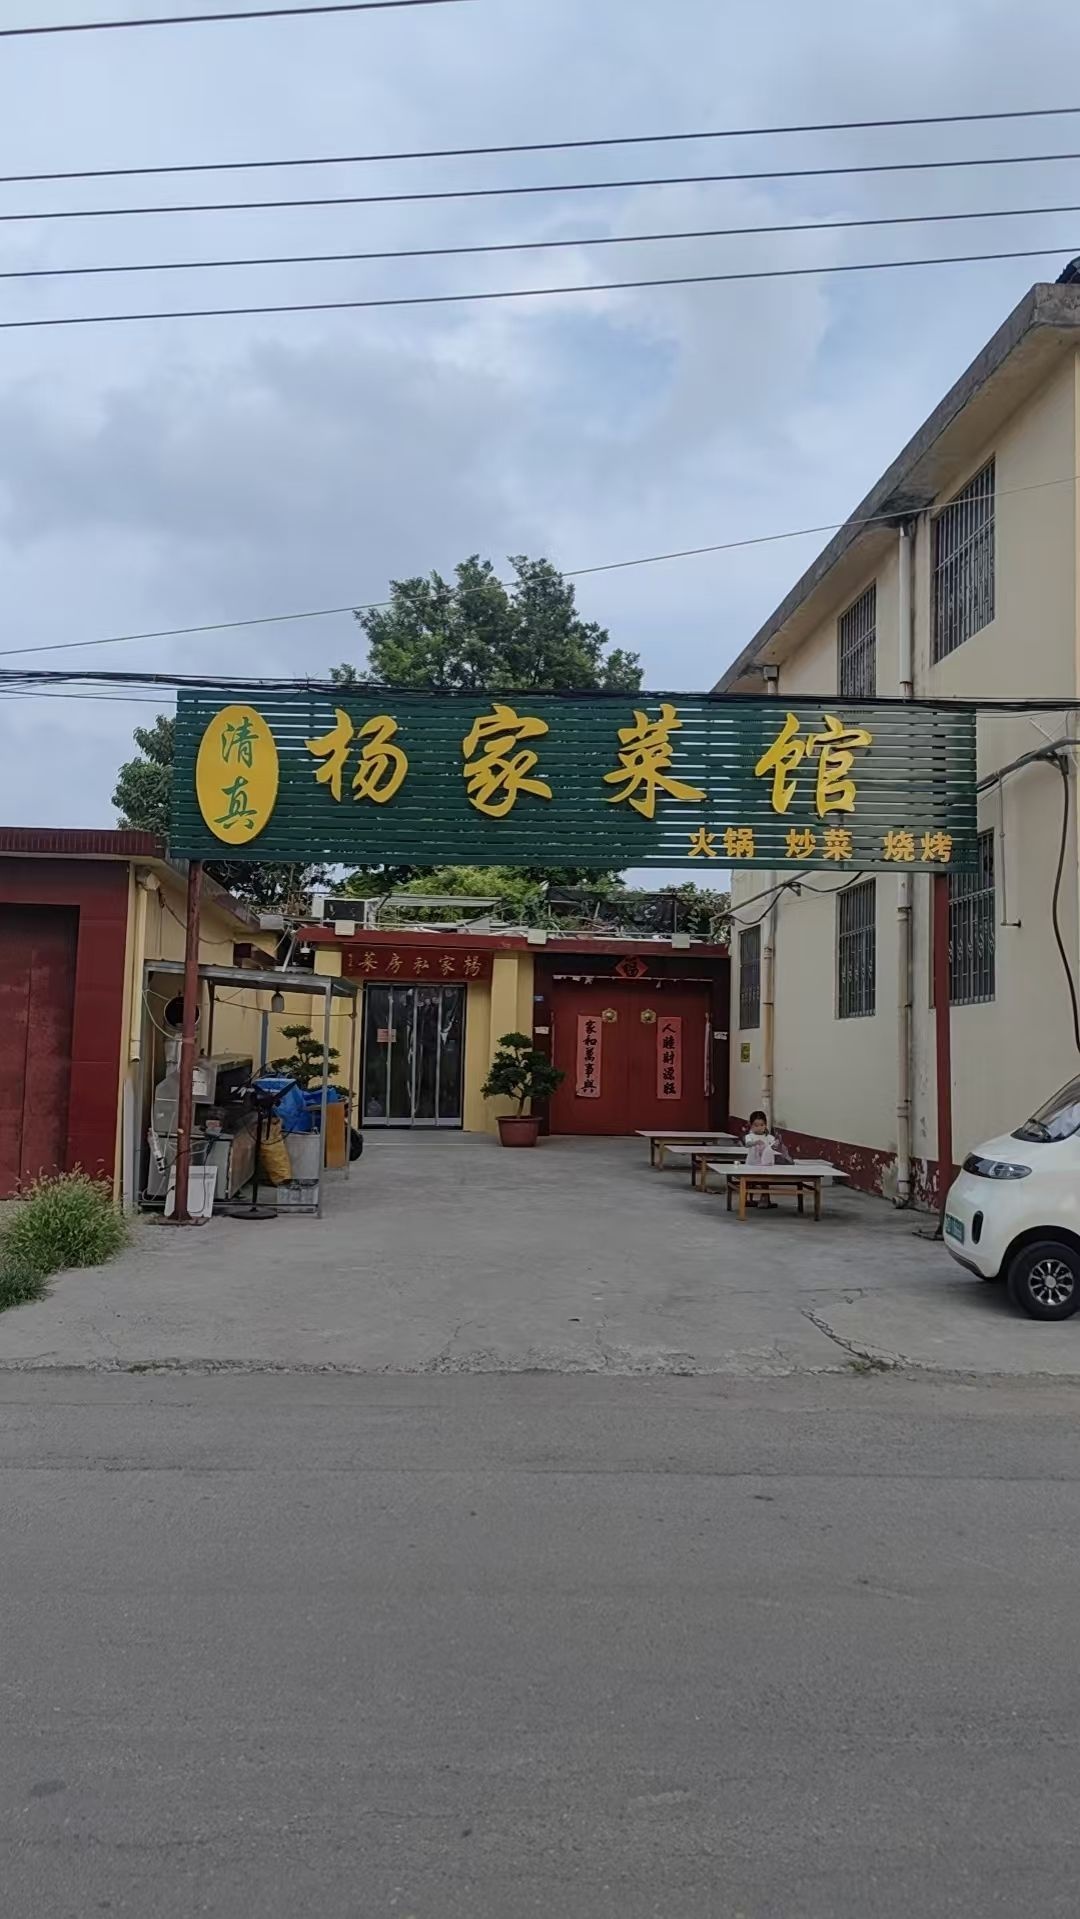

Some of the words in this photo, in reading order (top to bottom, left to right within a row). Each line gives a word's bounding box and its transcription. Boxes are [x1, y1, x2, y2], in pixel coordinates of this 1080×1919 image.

[213, 716, 259, 830] 清真
[304, 703, 872, 818] 杨家菜馆
[688, 828, 755, 858] 火锅
[785, 829, 853, 861] 炒菜
[884, 831, 953, 864] 烧烤
